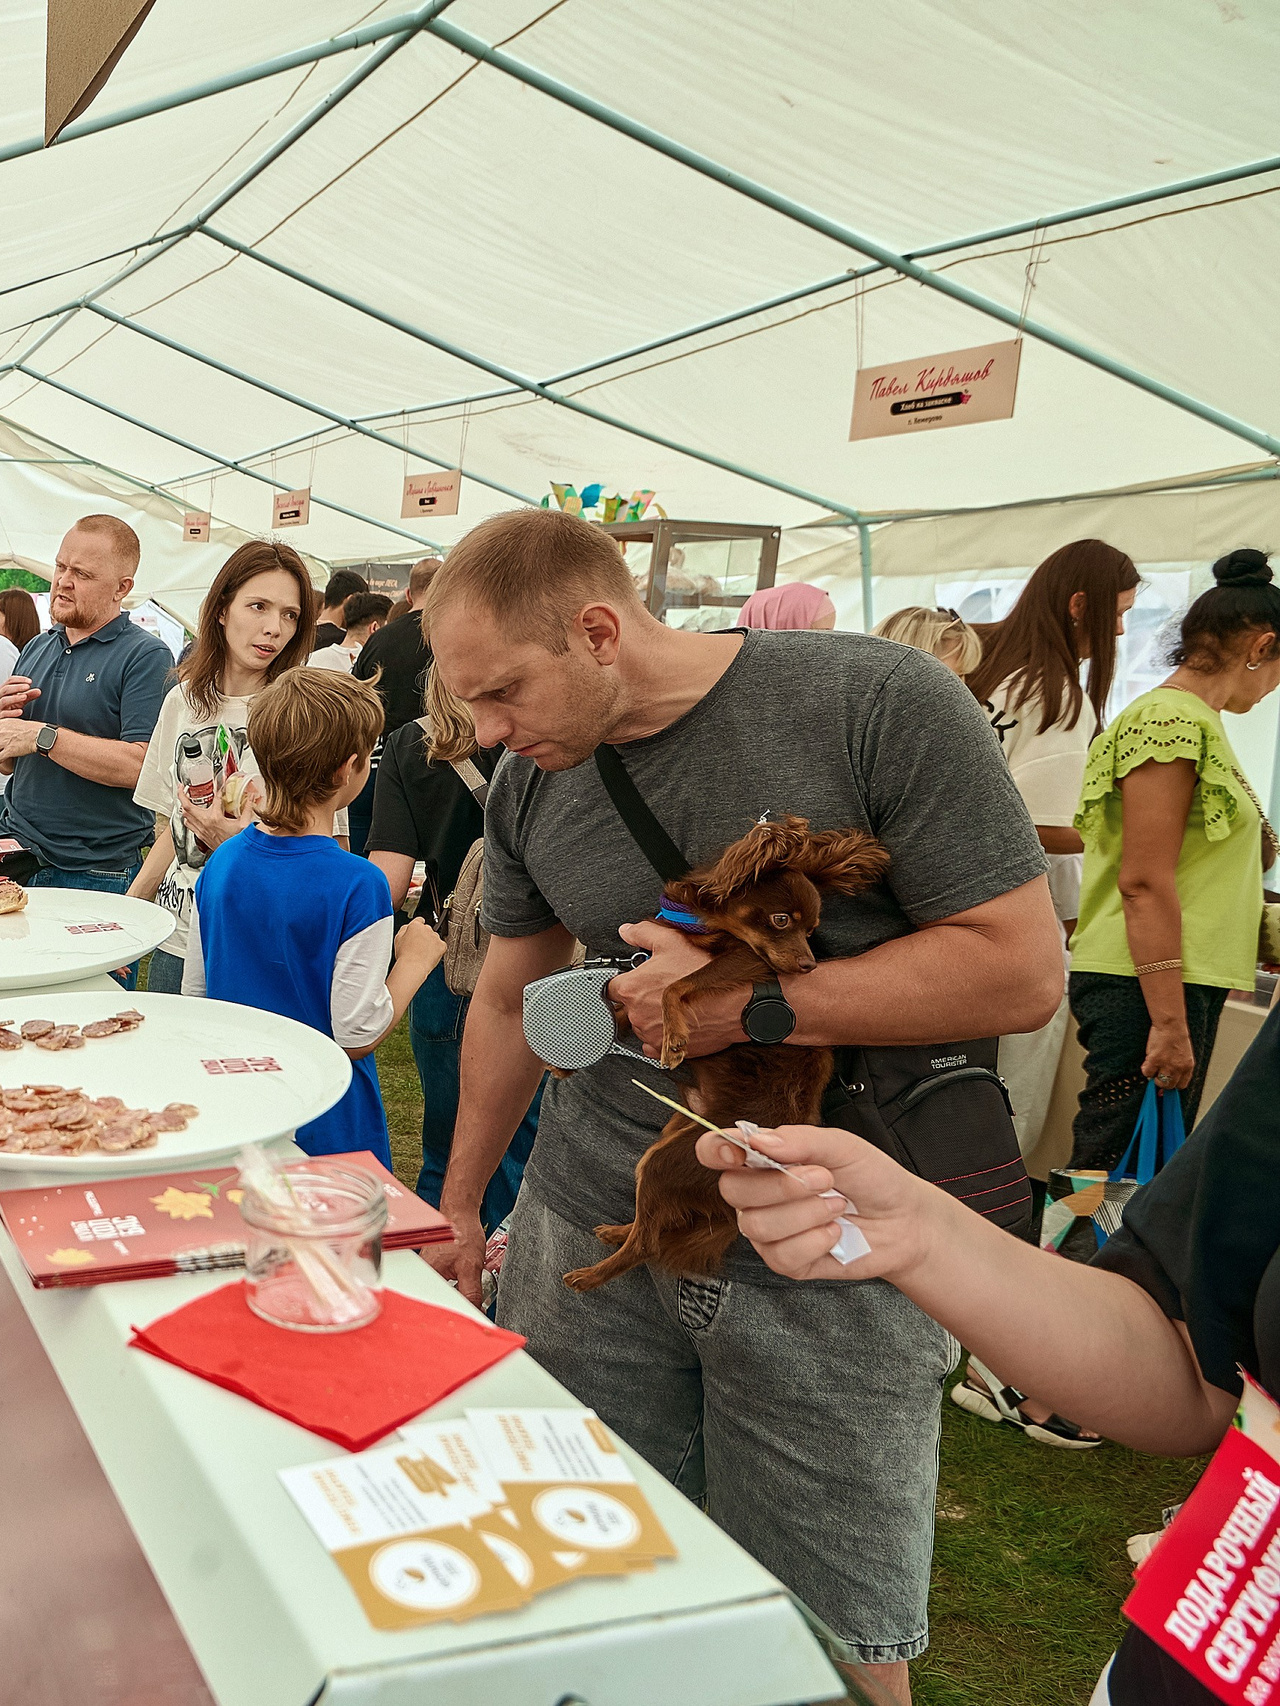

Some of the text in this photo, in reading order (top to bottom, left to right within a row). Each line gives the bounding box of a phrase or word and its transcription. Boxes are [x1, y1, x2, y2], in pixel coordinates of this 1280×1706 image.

[869, 376, 910, 401] Павел
[930, 1054, 967, 1065] AMERICAN
[931, 1059, 967, 1070] TOURISTER
[1164, 1466, 1280, 1652] ПОДАРОЧНЫЙ
[1204, 1528, 1280, 1684] СЕРТИФИ
